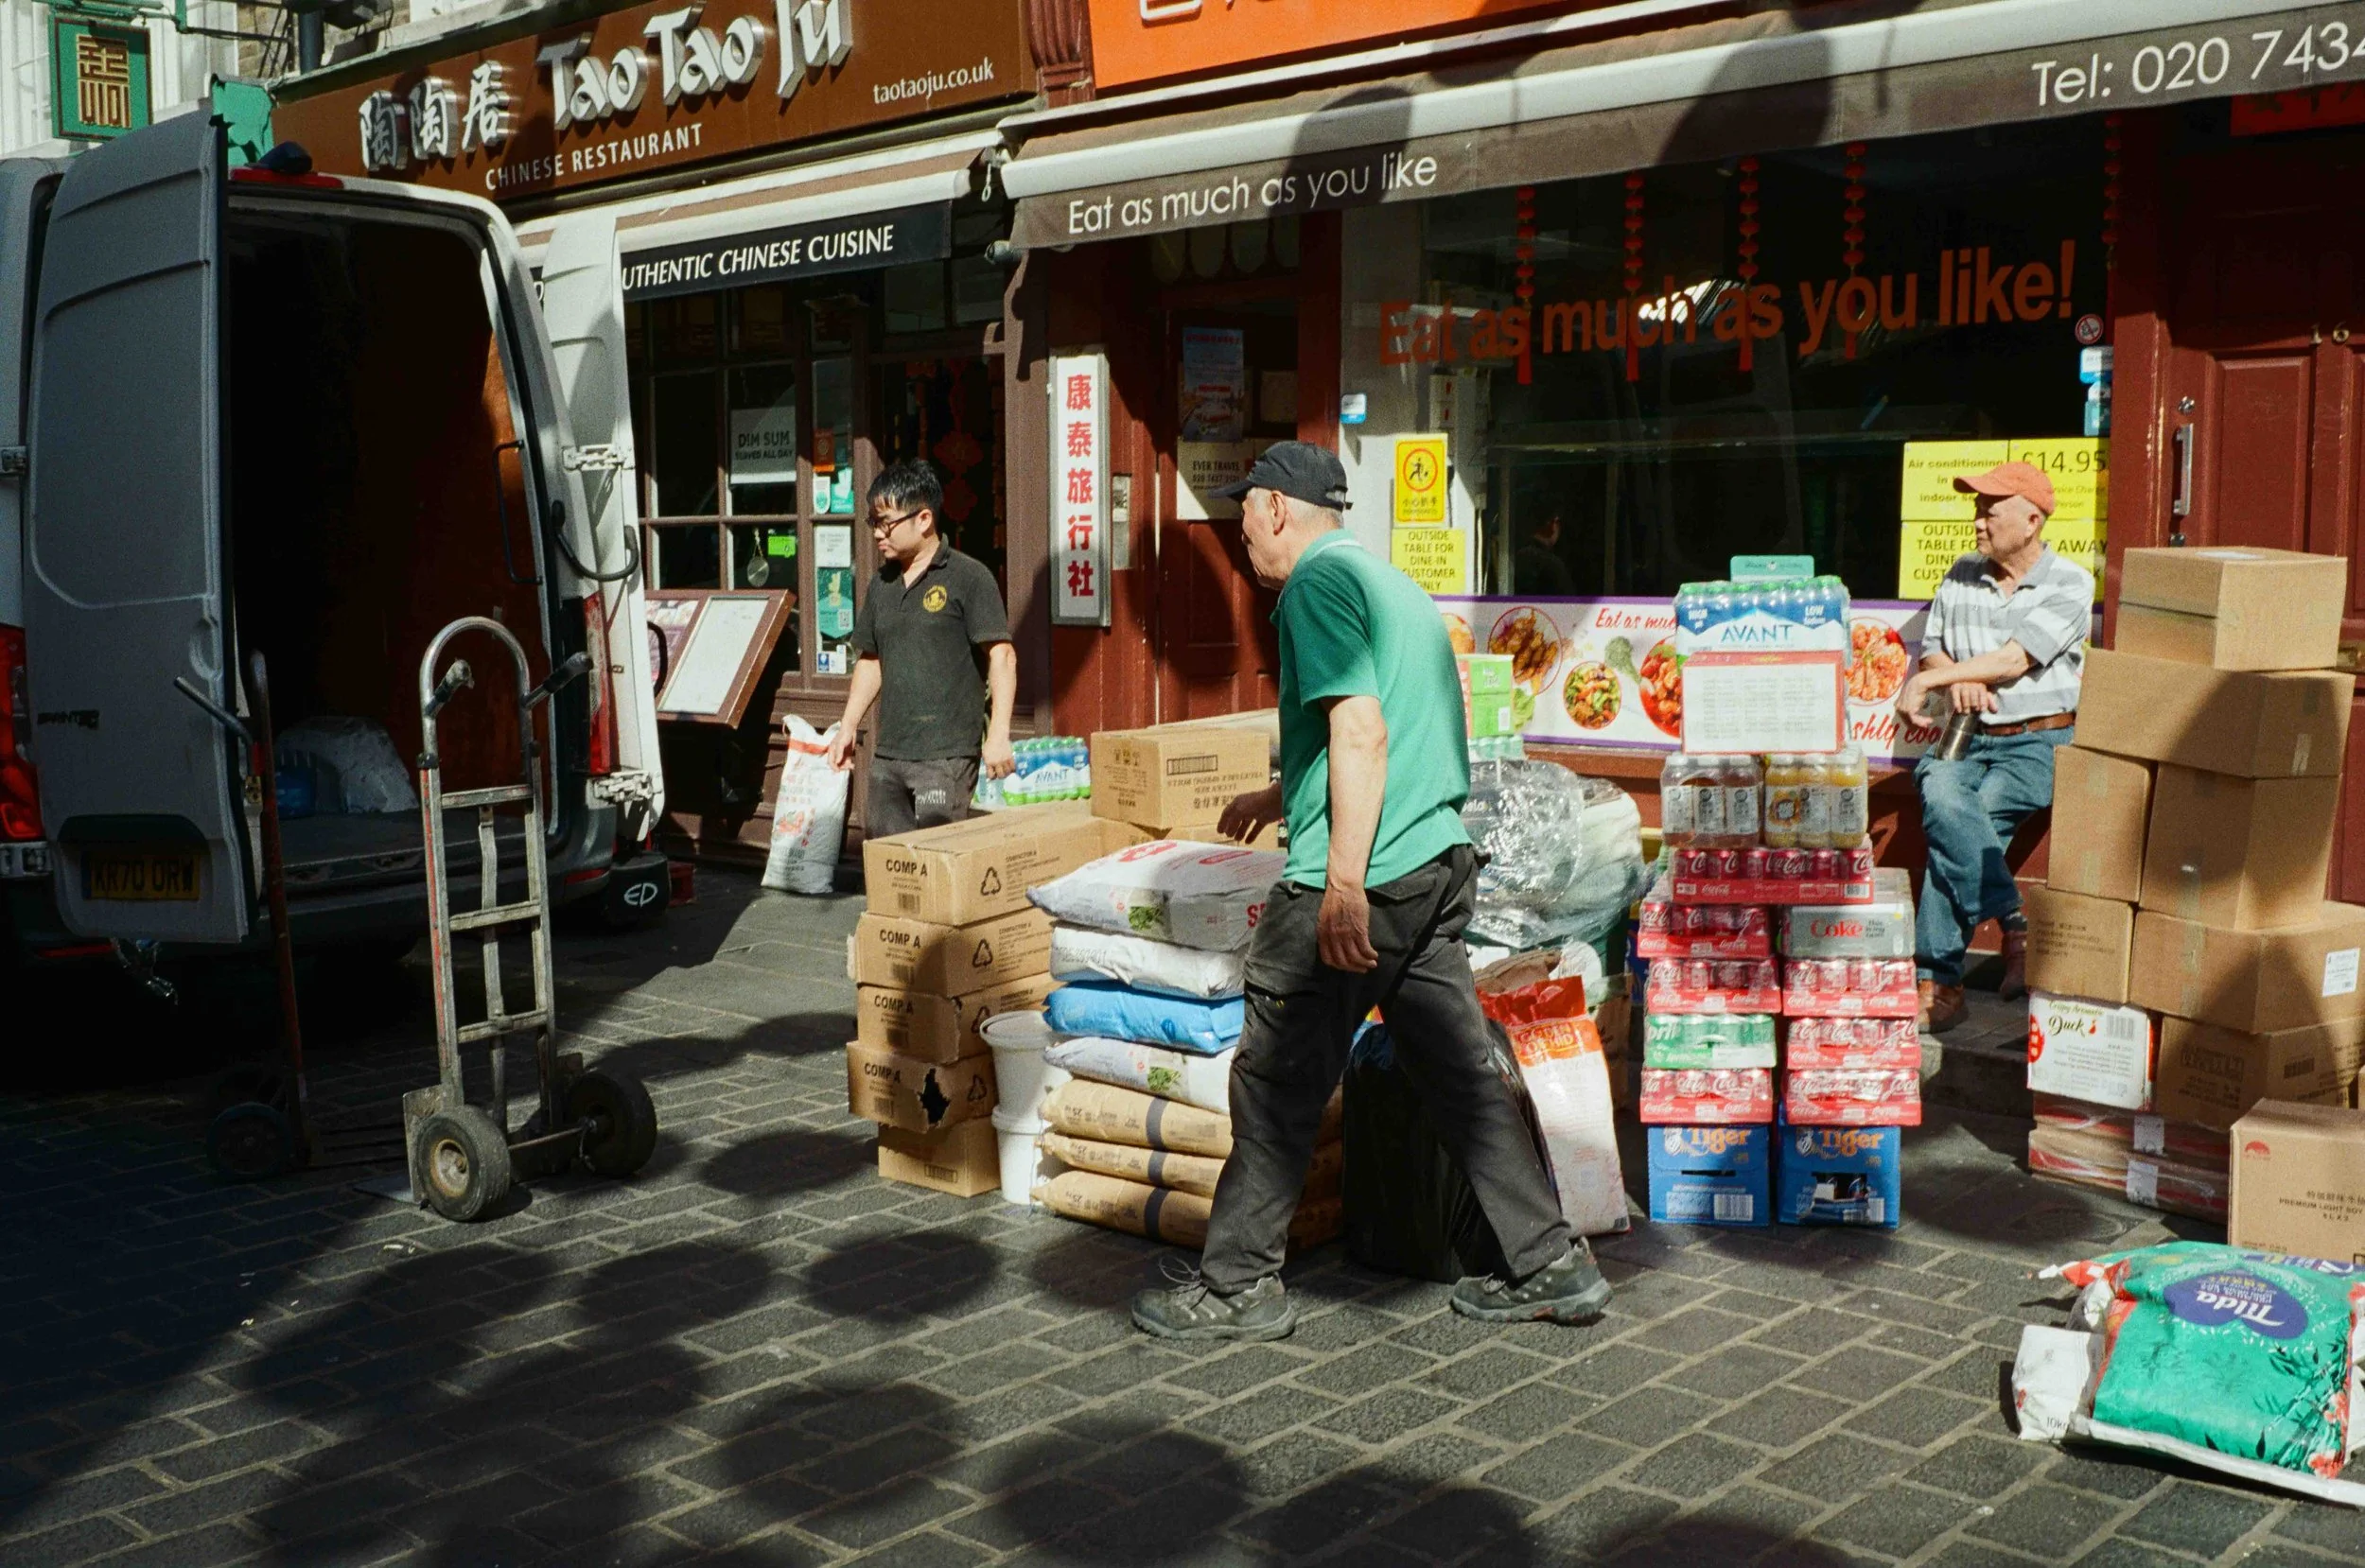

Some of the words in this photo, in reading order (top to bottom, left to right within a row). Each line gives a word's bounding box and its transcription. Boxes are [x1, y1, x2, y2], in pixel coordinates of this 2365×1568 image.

[535, 31, 648, 131] Tao
[643, 3, 764, 106] Tao
[774, 0, 852, 98] Ju
[2032, 53, 2112, 106] Tel:
[2132, 37, 2230, 94] 020
[873, 57, 994, 104] taotaoju.co.uk
[359, 61, 506, 171] 陶陶居
[485, 153, 564, 190] CHINESE
[571, 123, 703, 172] RESTAURANT
[1068, 199, 1113, 235] Eat
[1121, 199, 1152, 228] as
[1162, 176, 1250, 220] much
[1261, 175, 1297, 207] as
[1307, 165, 1370, 208] you
[1381, 151, 1438, 190] like
[622, 253, 713, 290] UTHENTIC
[718, 239, 802, 275] CHINESE
[808, 224, 894, 262] CUISINE
[1379, 298, 1459, 368] Eat
[1469, 305, 1529, 360] as
[1541, 273, 1697, 355] much
[1713, 284, 1784, 342] as
[1798, 273, 1917, 355] you
[1939, 239, 2076, 328] like!
[738, 433, 760, 447] DIM
[763, 430, 791, 446] SUM
[1908, 459, 1923, 468] Air
[1928, 459, 2003, 470] conditioning
[1066, 375, 1094, 597] 康泰旅行社
[1937, 476, 1949, 484] in
[1920, 493, 1956, 502] indoor
[1408, 531, 1449, 541] OUTSIDE
[1923, 525, 1974, 536] OUTSID
[1404, 543, 1432, 553] TABLE
[1435, 543, 1455, 553] FOR
[1918, 539, 1956, 550] TABLE
[1961, 539, 1978, 550] FO
[1595, 607, 1620, 629] Eat
[1624, 617, 1641, 629] as
[1722, 624, 1794, 642] AVANT
[1853, 713, 1900, 750] shly
[1904, 725, 1943, 745] coo
[1035, 768, 1070, 784] AVANT
[885, 859, 917, 875] COMP
[920, 864, 928, 877] A
[1810, 918, 1863, 938] Coke
[879, 929, 910, 946] COMP
[914, 936, 921, 949] A
[874, 995, 903, 1010] COMP
[906, 1002, 914, 1015] A
[2048, 1016, 2086, 1037] Duck
[865, 1063, 894, 1079] COMP
[894, 1070, 902, 1084] A
[1687, 1127, 1751, 1155] Tiger
[1819, 1128, 1884, 1156] Tiger
[2279, 1197, 2317, 1210] PREMIUM
[2196, 1290, 2285, 1327] Tilda
